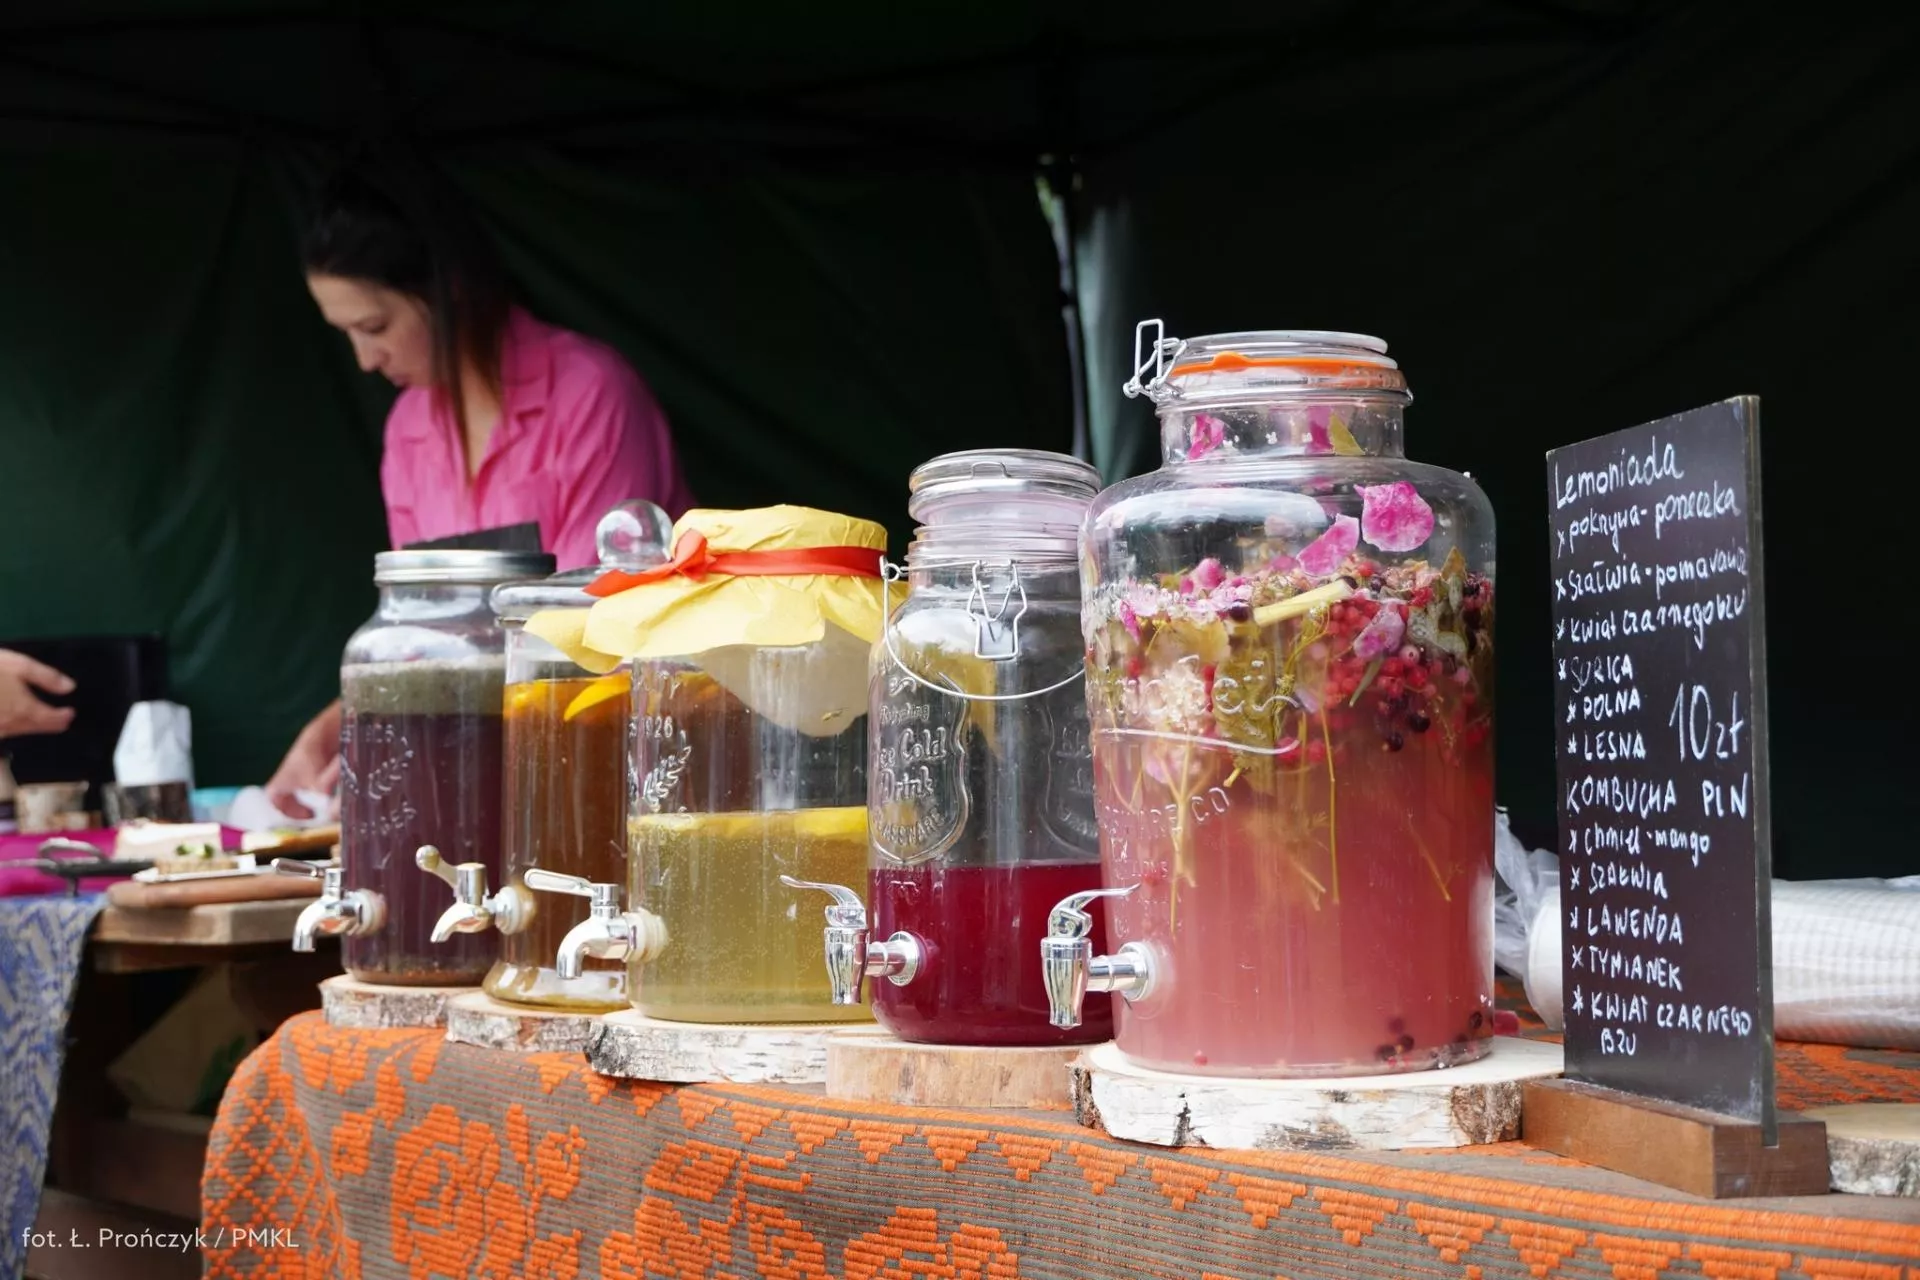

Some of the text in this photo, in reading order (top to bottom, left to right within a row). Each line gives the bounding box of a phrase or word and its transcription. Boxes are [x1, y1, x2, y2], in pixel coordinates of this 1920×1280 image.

[1555, 436, 1685, 510] Lemoniada
[1583, 685, 1642, 722] POLNA
[902, 726, 947, 762] Cold
[1566, 772, 1749, 820] KOMBUCHA PLN
[1587, 902, 1684, 945] LAWENDA
[1656, 1003, 1753, 1037] CZARNEGO
[1600, 1028, 1637, 1057] BZU
